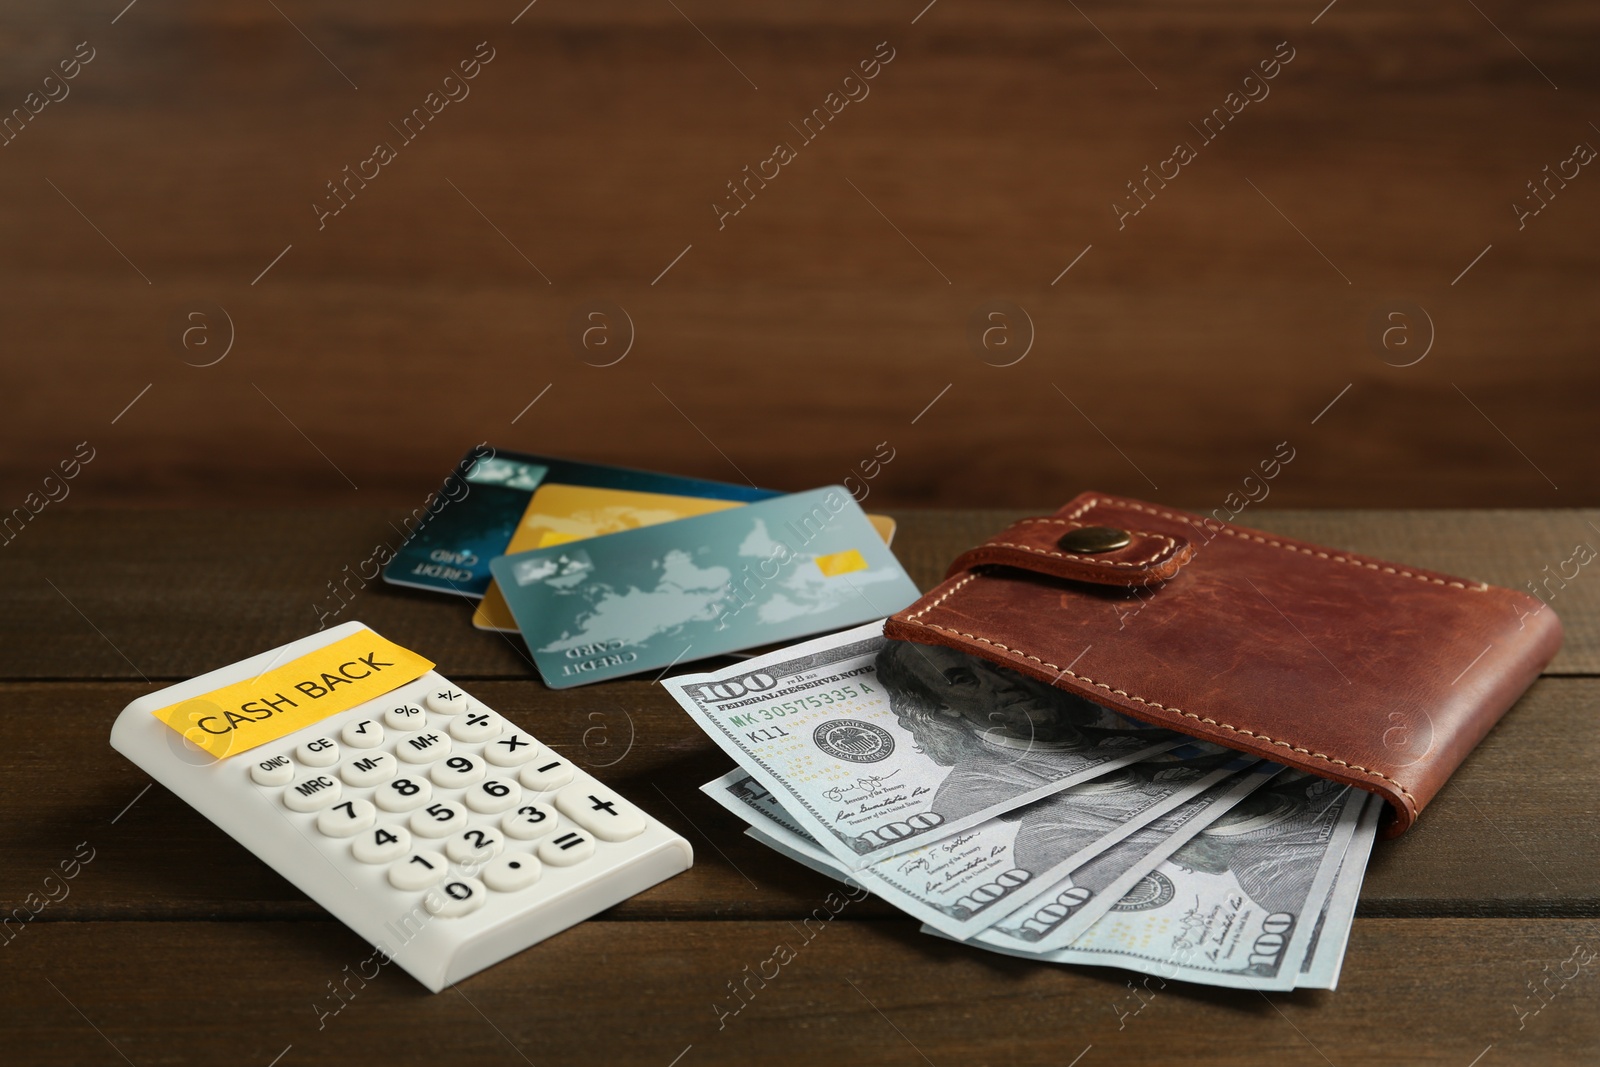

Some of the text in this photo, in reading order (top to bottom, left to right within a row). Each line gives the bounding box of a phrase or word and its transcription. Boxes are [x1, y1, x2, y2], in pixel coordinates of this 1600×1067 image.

[430, 549, 479, 567] CARD
[411, 562, 473, 582] CREDIT
[565, 639, 625, 660] CARD
[561, 651, 638, 677] CREDIT
[197, 652, 395, 736] CASH BACK
[698, 673, 778, 704] 100
[716, 665, 875, 712] FEDERAL RESERVE NOTE
[729, 712, 759, 728] MK
[758, 686, 858, 721] 30575335
[859, 682, 875, 695] A
[408, 733, 439, 751] M+
[746, 726, 789, 744] K11
[307, 738, 334, 753] CE
[259, 755, 290, 772] ON/C
[446, 756, 473, 773] 9
[294, 776, 334, 797] MRC
[391, 778, 420, 796] 8
[482, 780, 510, 797] 6
[331, 801, 357, 819] 7
[426, 803, 455, 821] 5
[518, 806, 546, 823] 3
[375, 827, 398, 846] 4
[856, 811, 945, 848] 100
[463, 830, 494, 849] 2
[410, 855, 434, 870] 1
[445, 882, 473, 900] 0
[951, 868, 1033, 915] 100
[1018, 886, 1094, 935] 100
[1248, 911, 1296, 967] 100
